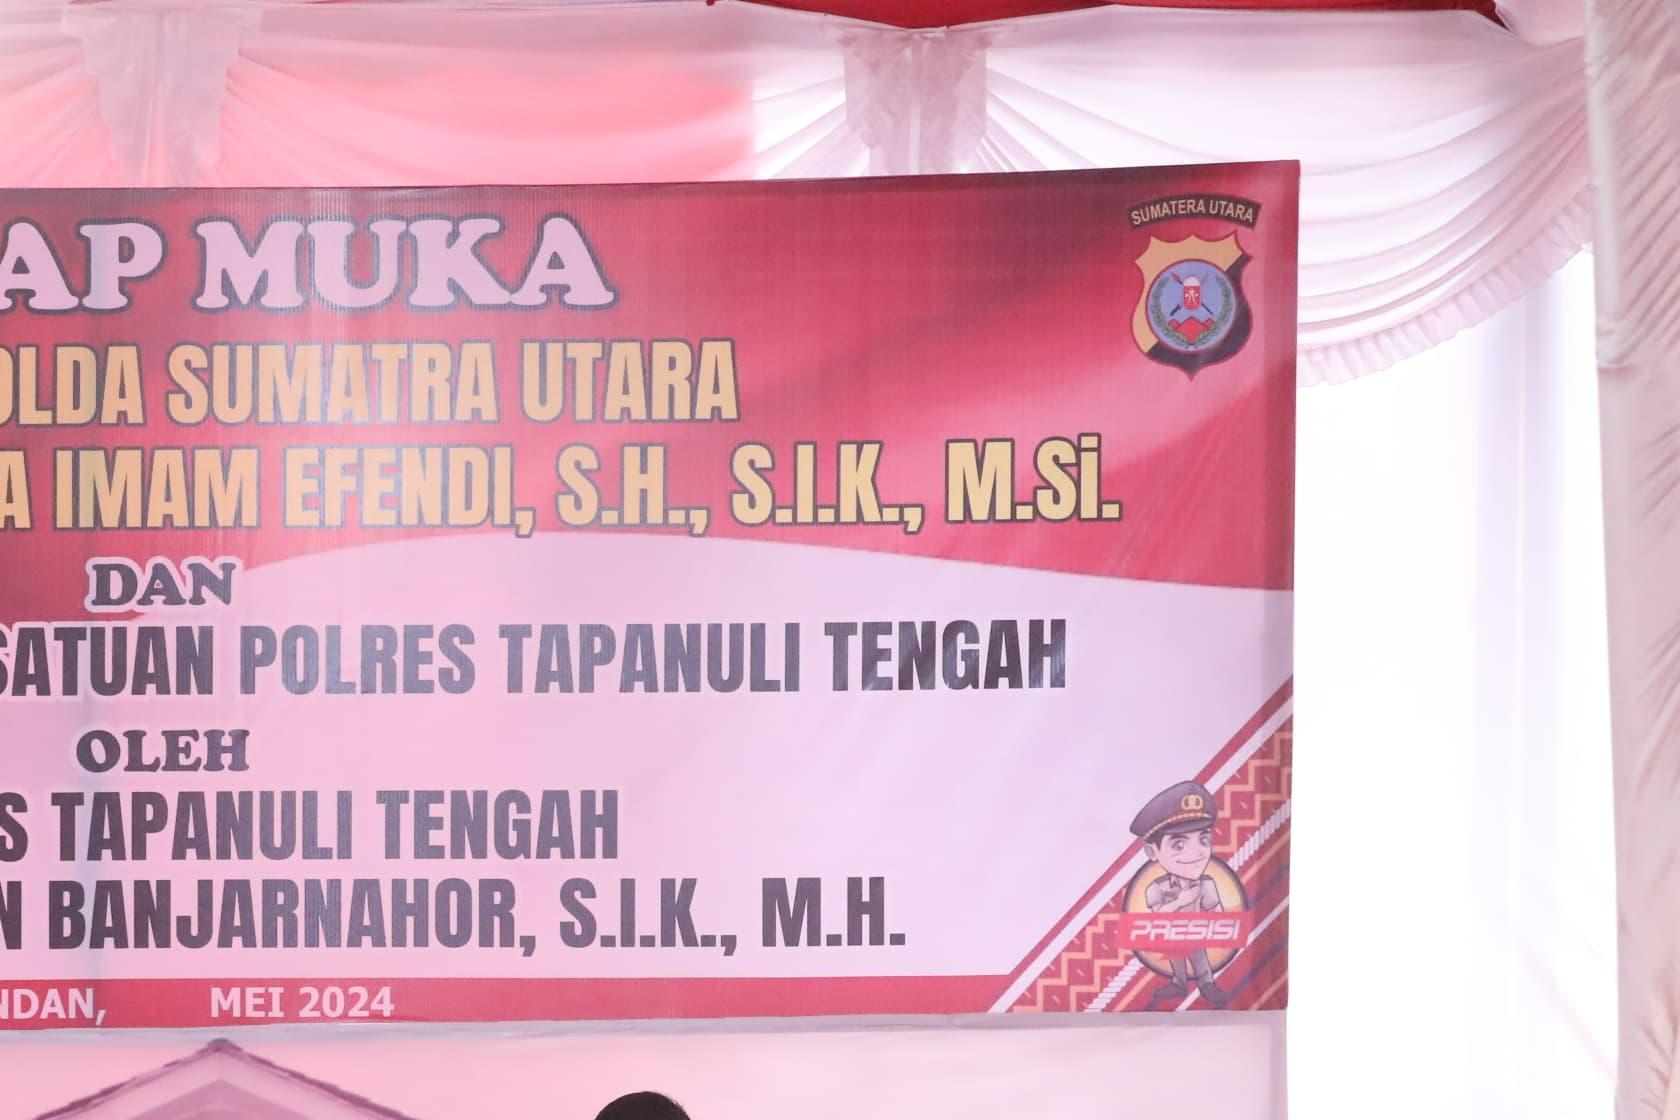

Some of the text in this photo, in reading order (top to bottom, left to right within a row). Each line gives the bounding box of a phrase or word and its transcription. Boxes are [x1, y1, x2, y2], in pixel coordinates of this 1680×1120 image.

[1131, 199, 1253, 225] SUMATERA UTARA
[194, 216, 616, 310] MUKA
[166, 341, 500, 424] SUMATRA
[521, 339, 739, 422] UTARA
[55, 448, 259, 530] IMAM
[283, 444, 534, 537] EFENDI,
[556, 443, 710, 535] S.H.,
[730, 440, 923, 533] S.I.K.,
[945, 433, 1121, 523] M.Si.
[91, 562, 237, 607] DAN
[238, 623, 477, 696] POLRES
[498, 622, 801, 694] TAPANULI
[823, 618, 1067, 692] TENGAH
[76, 728, 251, 773] OLEH
[51, 790, 353, 861] TAPANULI
[375, 788, 619, 860] TENGAH
[47, 876, 537, 958] BANJARNAHOR,
[558, 877, 738, 957] S.I.K.,
[760, 875, 907, 948] M.H.
[1128, 919, 1242, 942] PRESISI
[209, 986, 286, 1019] MEI
[298, 984, 395, 1019] 2024
